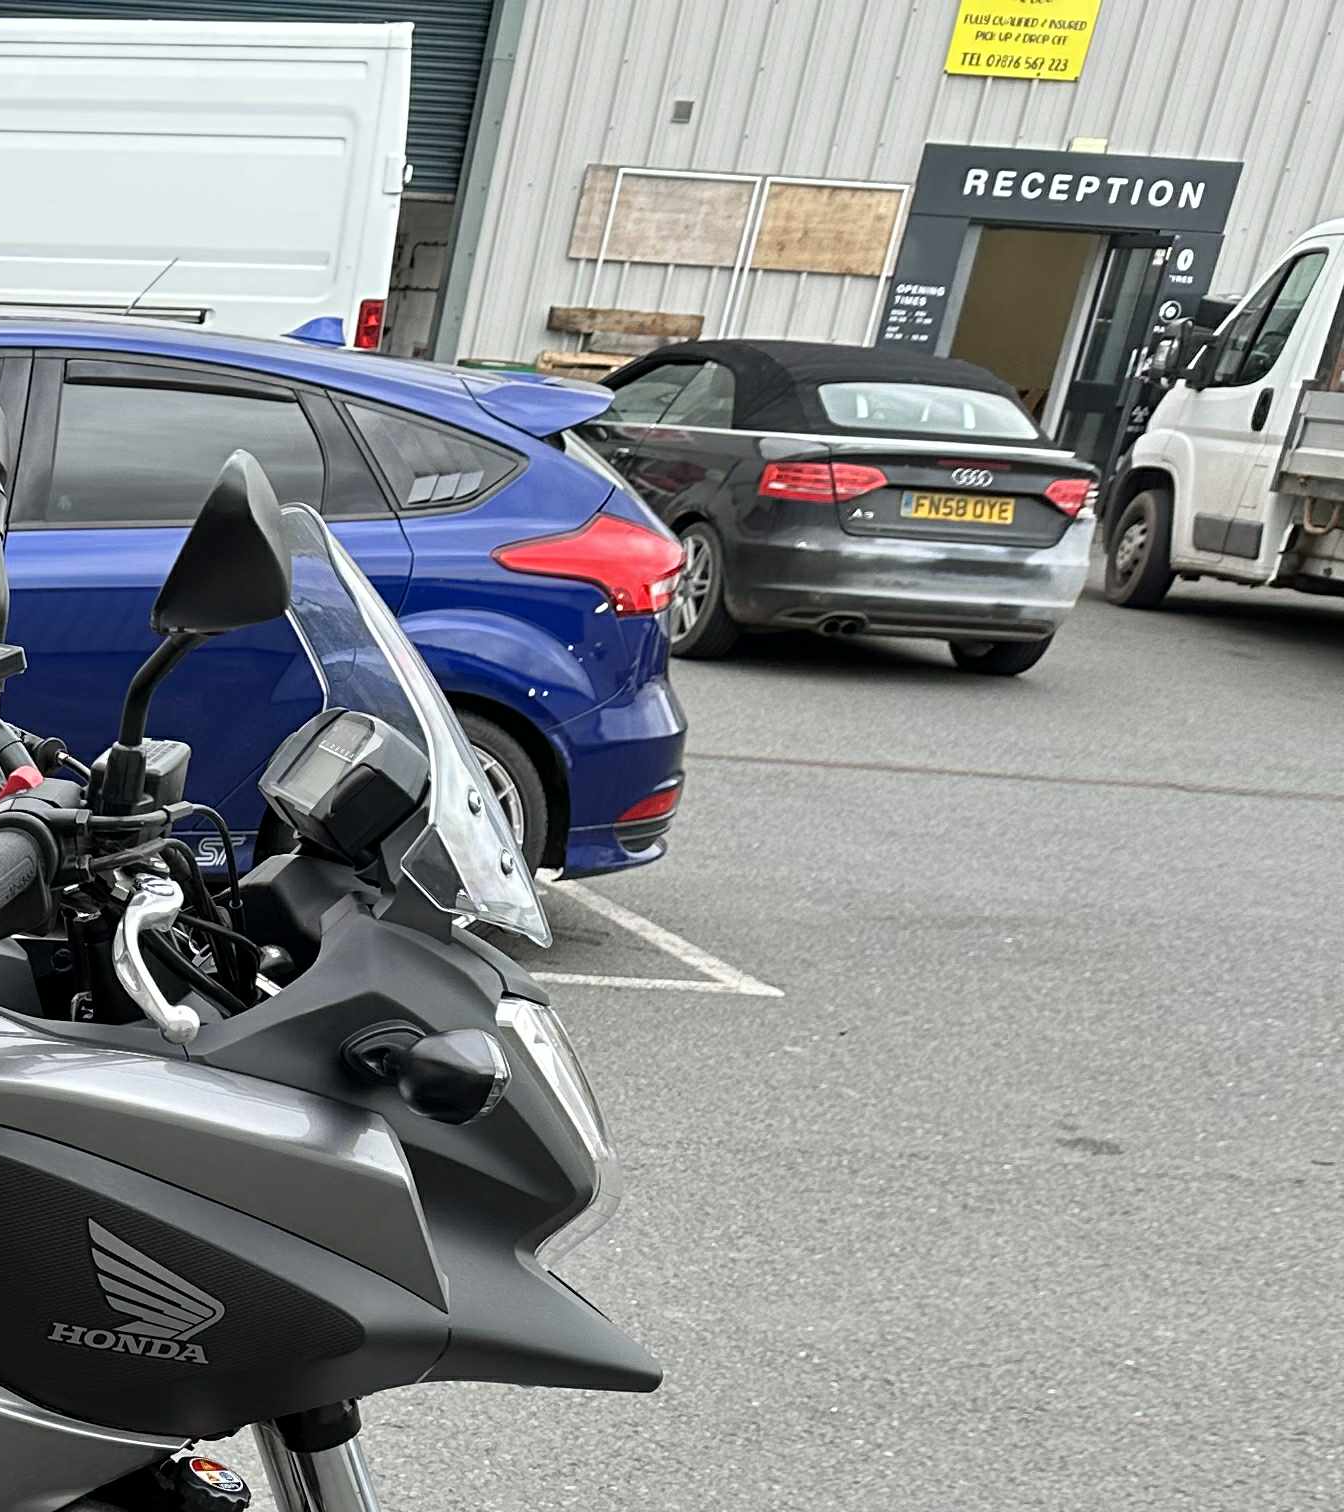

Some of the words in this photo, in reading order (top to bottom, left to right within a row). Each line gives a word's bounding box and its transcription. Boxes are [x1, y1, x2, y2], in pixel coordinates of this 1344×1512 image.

[1048, 20, 1088, 31] INSURED
[998, 32, 1012, 42] UP
[960, 52, 982, 66] TEL
[1024, 57, 1045, 71] 567
[1048, 58, 1069, 72] 223
[963, 168, 1206, 209] RECEPTION
[914, 495, 967, 516] FN58
[47, 1322, 209, 1364] HONDA
